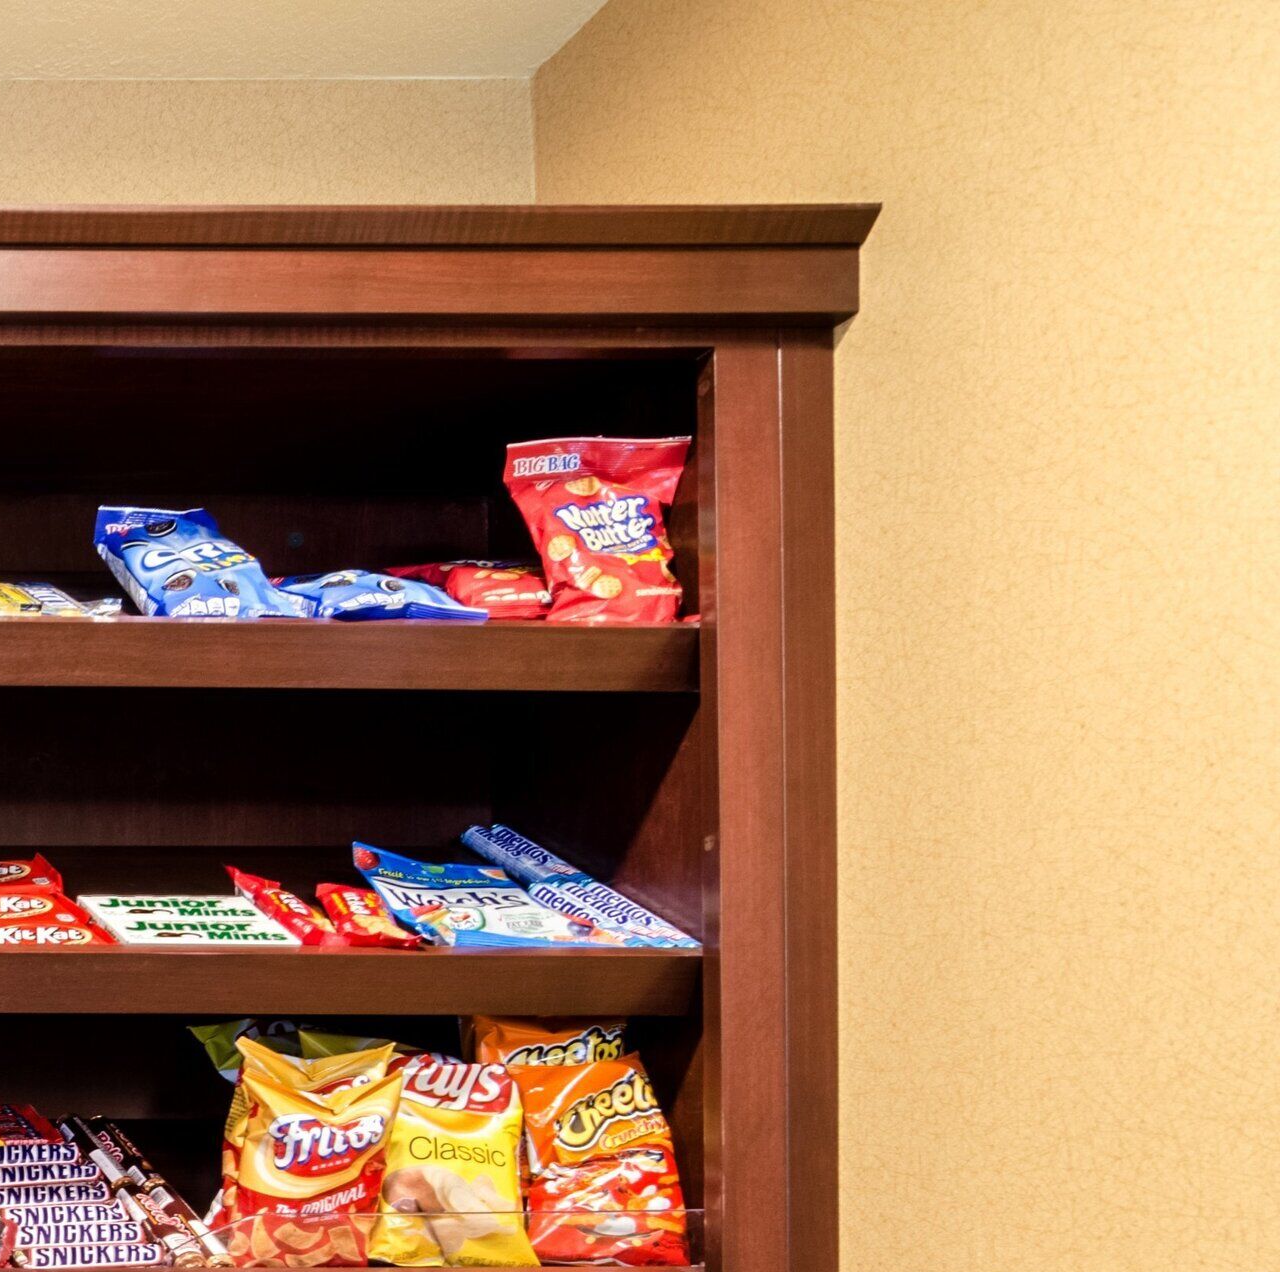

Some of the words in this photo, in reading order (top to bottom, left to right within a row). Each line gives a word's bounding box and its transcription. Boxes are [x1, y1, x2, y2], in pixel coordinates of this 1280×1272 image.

[513, 456, 545, 477] BIG
[546, 453, 580, 472] BAG
[143, 541, 240, 573] ORE
[496, 829, 553, 866] mentos
[98, 897, 223, 909] Junior
[178, 907, 257, 917] Mints
[533, 886, 600, 925] mentos
[565, 885, 628, 925] mentos
[591, 885, 657, 926] mentos
[125, 920, 253, 932] Junior
[207, 930, 288, 941] Mints
[555, 1072, 659, 1147] Cheet
[269, 1113, 384, 1171] Fritos
[409, 1136, 507, 1167] Classic
[9, 1203, 123, 1226] SNICKERS
[300, 1183, 366, 1218] ORIGINAL
[20, 1223, 139, 1246] SNICKERS
[36, 1244, 158, 1267] SNICKERS
